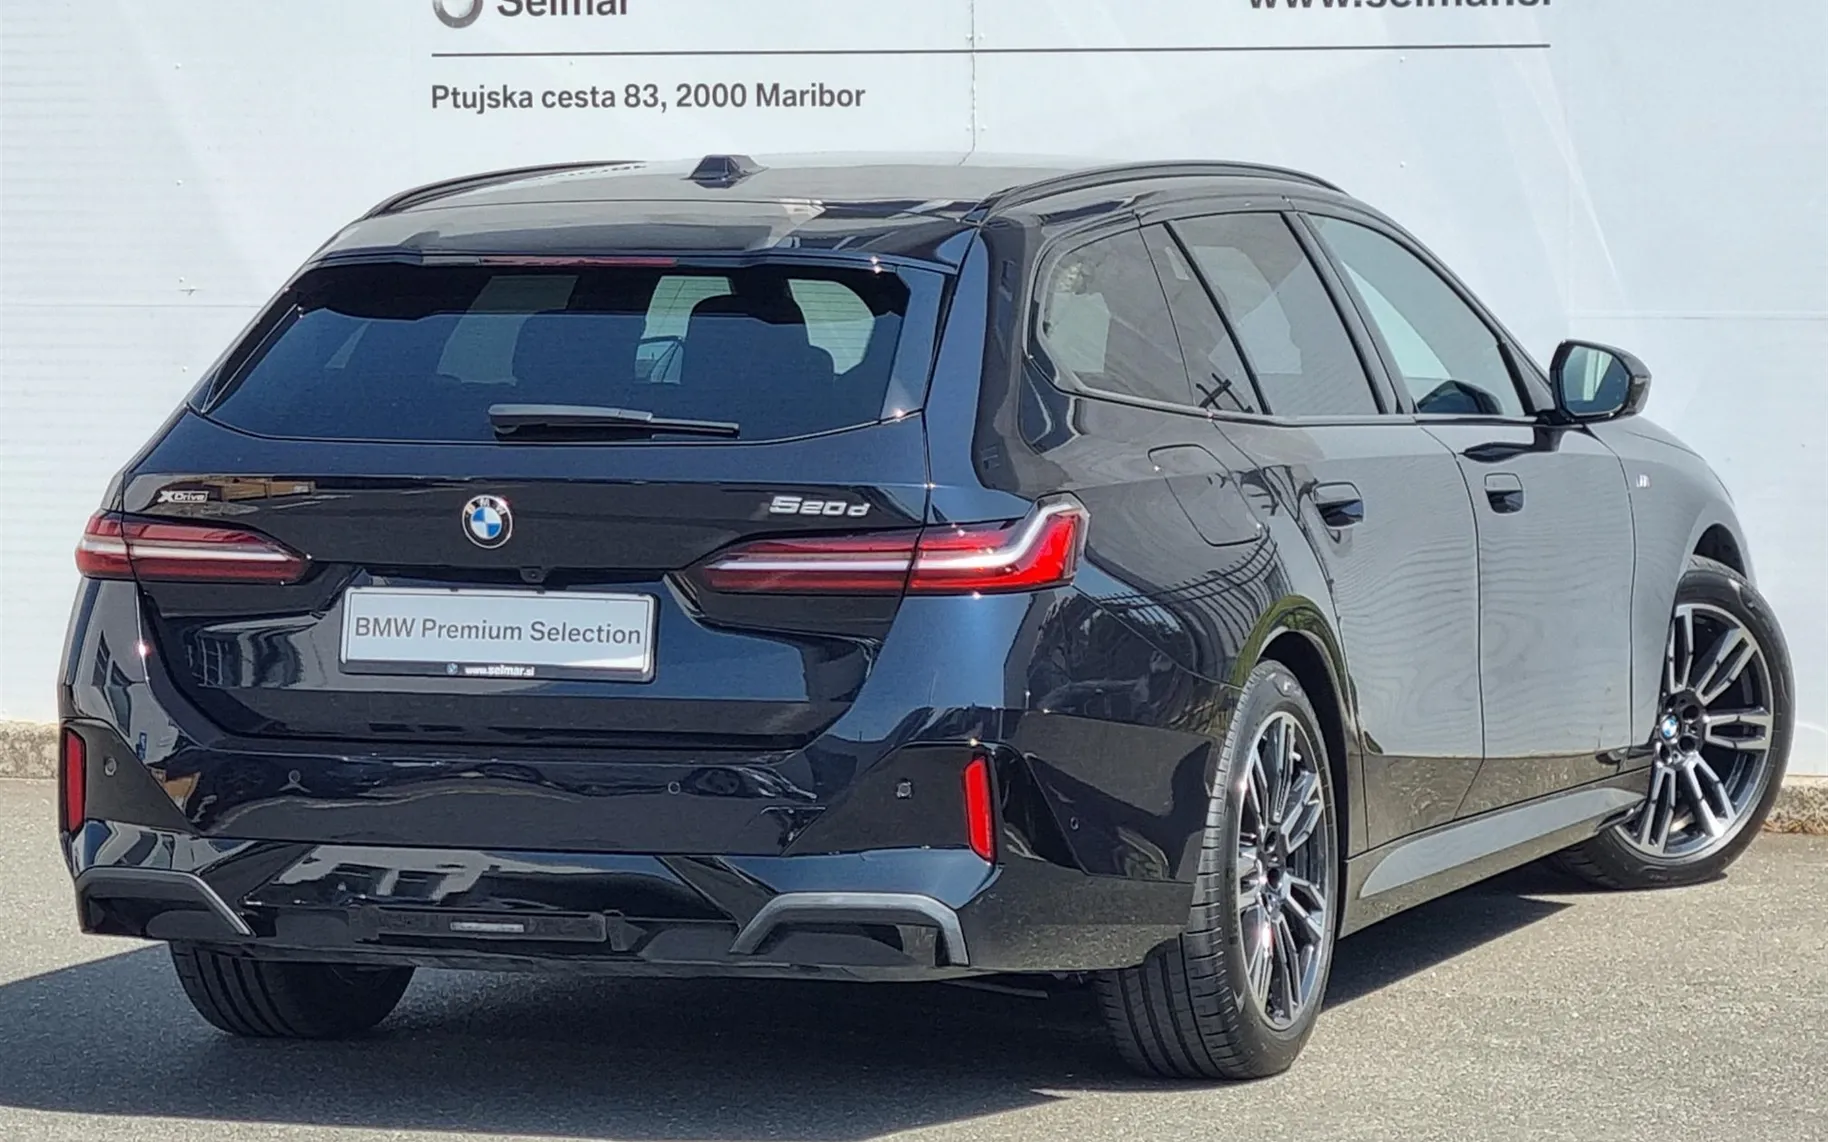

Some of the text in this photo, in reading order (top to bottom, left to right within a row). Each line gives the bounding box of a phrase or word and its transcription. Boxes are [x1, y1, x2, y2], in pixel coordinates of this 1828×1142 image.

[431, 83, 866, 115] Ptujska cesta 83, 2000 Maribor
[769, 495, 871, 516] 520d
[355, 616, 642, 645] BMW Premium Selection
[465, 664, 536, 677] www.selmar.si
